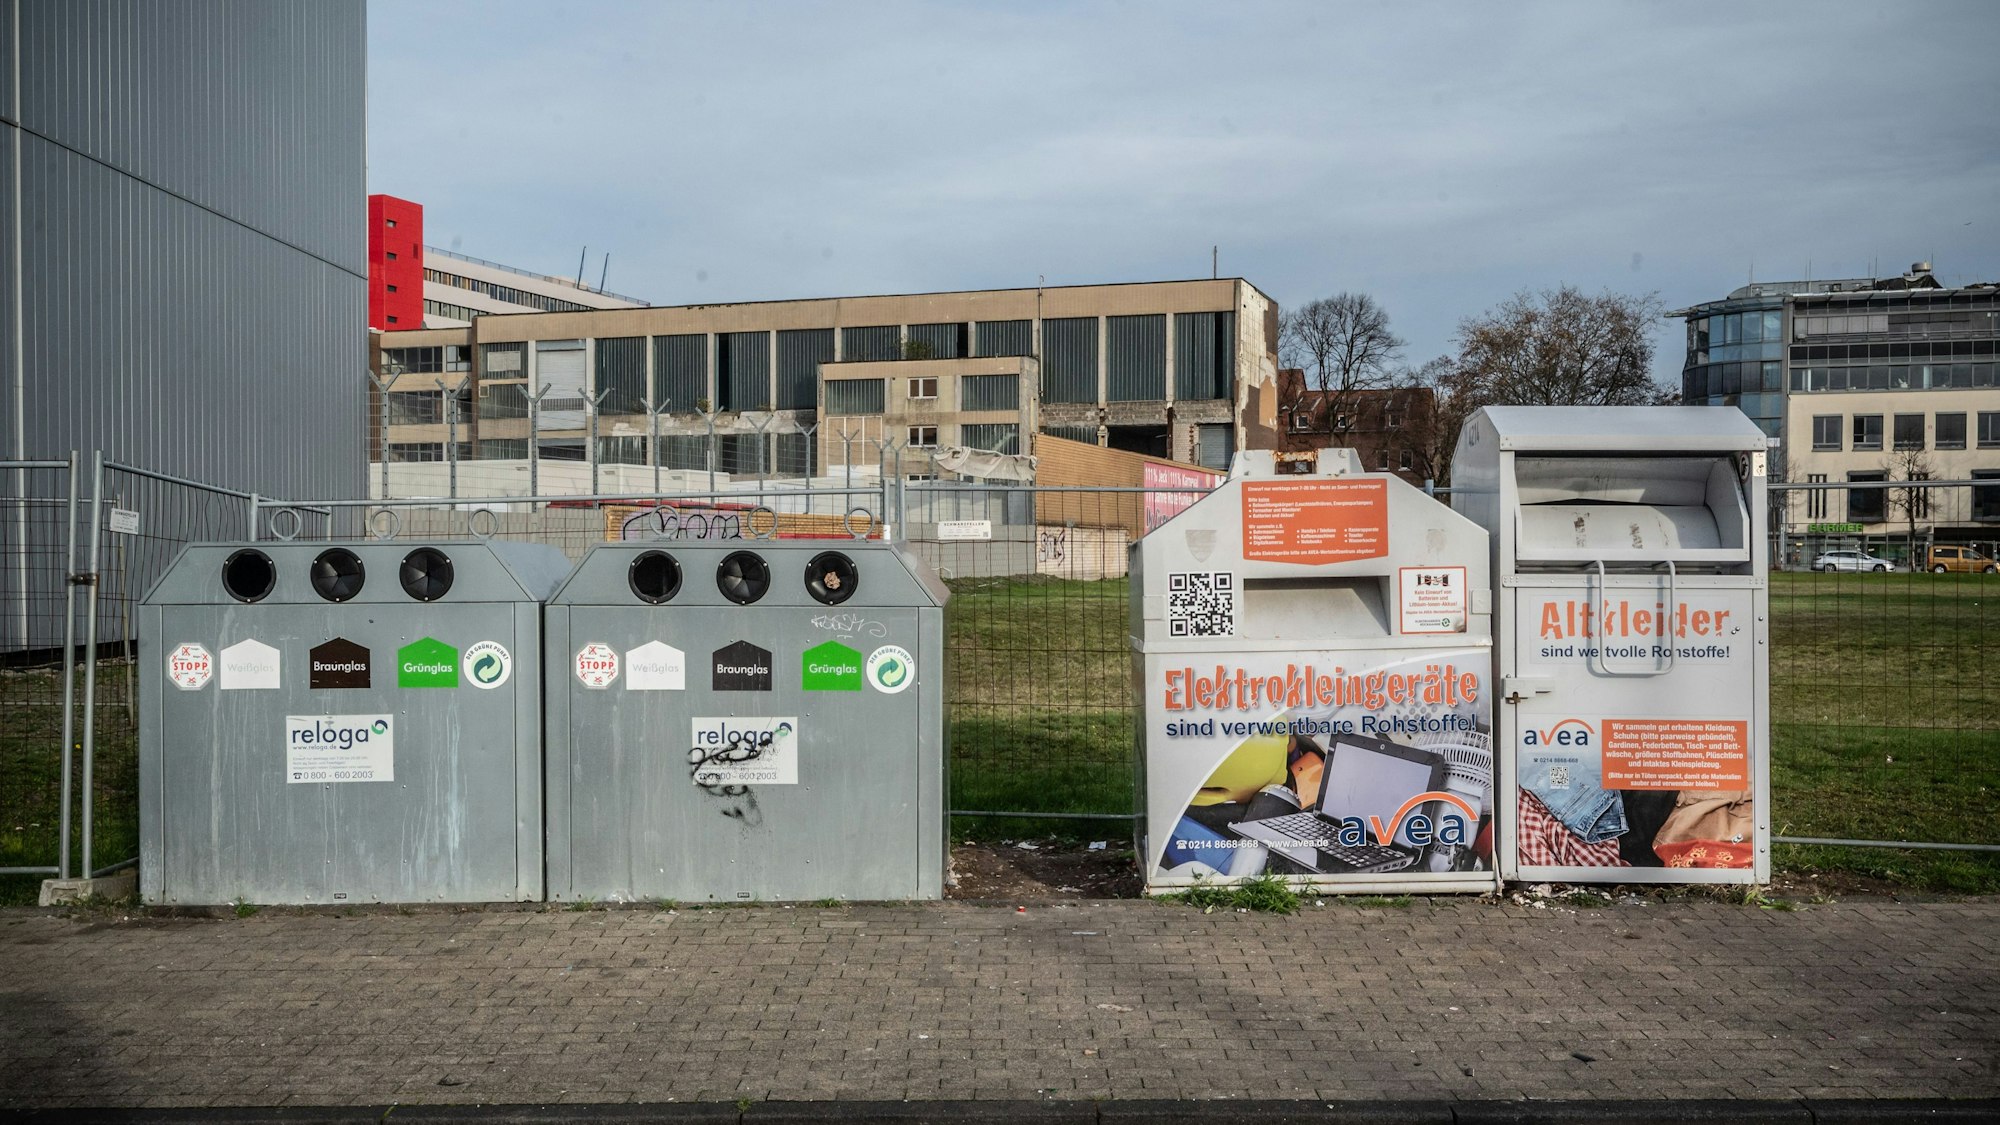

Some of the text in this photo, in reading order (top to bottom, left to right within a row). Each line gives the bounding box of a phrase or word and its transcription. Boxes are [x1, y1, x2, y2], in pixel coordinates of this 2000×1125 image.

[1540, 600, 1730, 640] Altkleider
[1541, 645, 1573, 658] sind
[1578, 646, 1646, 658] wetvolle
[174, 662, 208, 670] STOPP
[227, 663, 274, 674] Weißglas
[314, 660, 366, 674] Braunglas
[404, 662, 453, 674] Grünglas
[580, 662, 614, 670] STOPP
[632, 664, 680, 674] Weißglas
[717, 664, 768, 676] Braunglas
[809, 664, 858, 676] Grünglas
[1165, 664, 1478, 711] Elektrokleingeräte
[1166, 713, 1477, 736] sind verwertbare Rohstoffe!
[292, 720, 368, 750] reloga
[698, 722, 773, 752] reloga
[1524, 720, 1594, 746] avea
[1640, 732, 1658, 740] (bitte
[1660, 732, 1696, 741] paarweise
[1697, 732, 1736, 741] gebündelt),
[1608, 742, 1641, 750] Gardinen,
[1642, 742, 1684, 750] Federbetten,
[1635, 751, 1660, 760] größere
[1662, 752, 1704, 760] Stoffbahnen,
[1672, 760, 1721, 769] Kleinspielzeug.
[1338, 792, 1478, 847] avea
[1188, 839, 1328, 849] 0214 8668-668 www.avea.de
